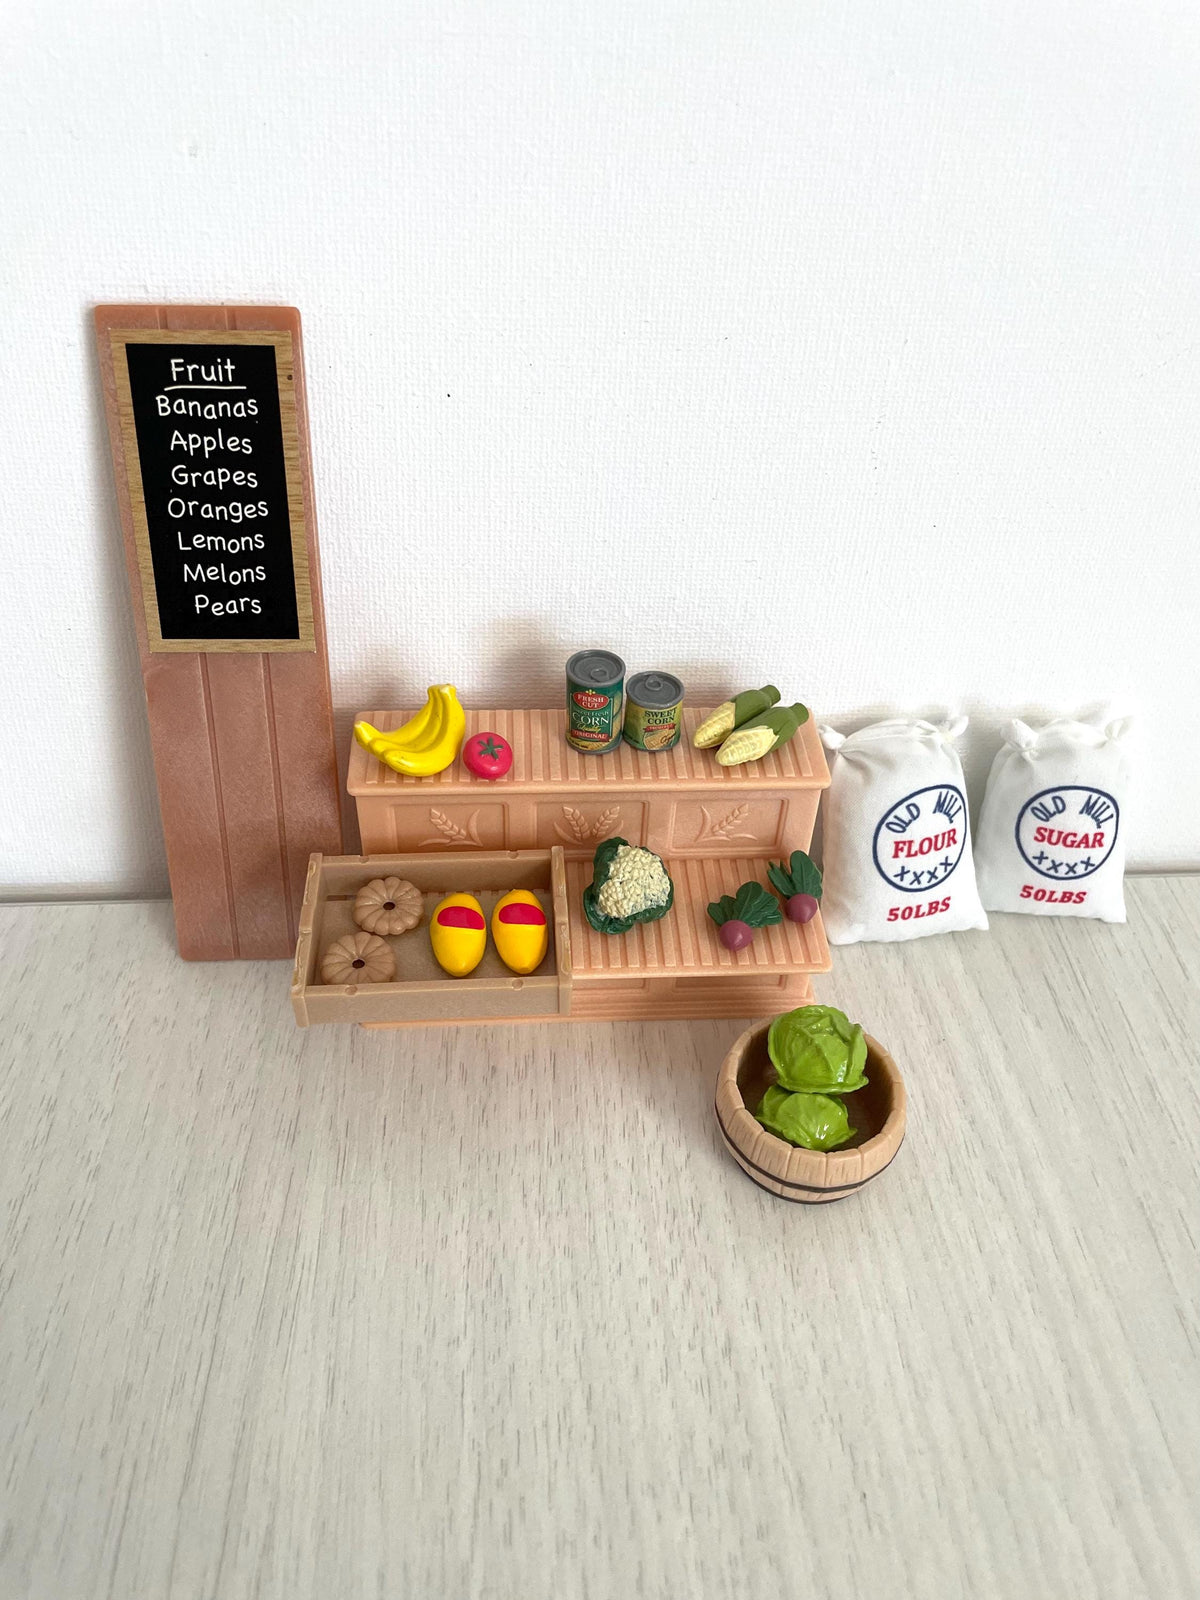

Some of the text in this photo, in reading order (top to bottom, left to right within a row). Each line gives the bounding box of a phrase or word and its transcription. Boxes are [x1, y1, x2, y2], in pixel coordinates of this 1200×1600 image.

[170, 358, 236, 383] Fruit
[155, 394, 259, 420] Bananas
[170, 428, 253, 459] Apples
[171, 464, 258, 490] Grapes
[167, 497, 269, 524] Oranges
[177, 531, 265, 554] Lemons
[183, 562, 266, 586] Melons
[194, 594, 262, 616] Pears
[577, 694, 604, 703] FRESH
[572, 711, 609, 726] CORN
[645, 707, 677, 718] SWEET
[647, 716, 675, 725] CORN
[574, 731, 606, 739] ORIGINAL
[885, 790, 963, 834] OLD MILL
[1030, 794, 1114, 829] OLD MILL
[892, 827, 958, 860] FLOUR
[1033, 826, 1105, 850] SUGAR
[1019, 885, 1088, 905] 50LBS
[887, 896, 952, 922] 50LBS
